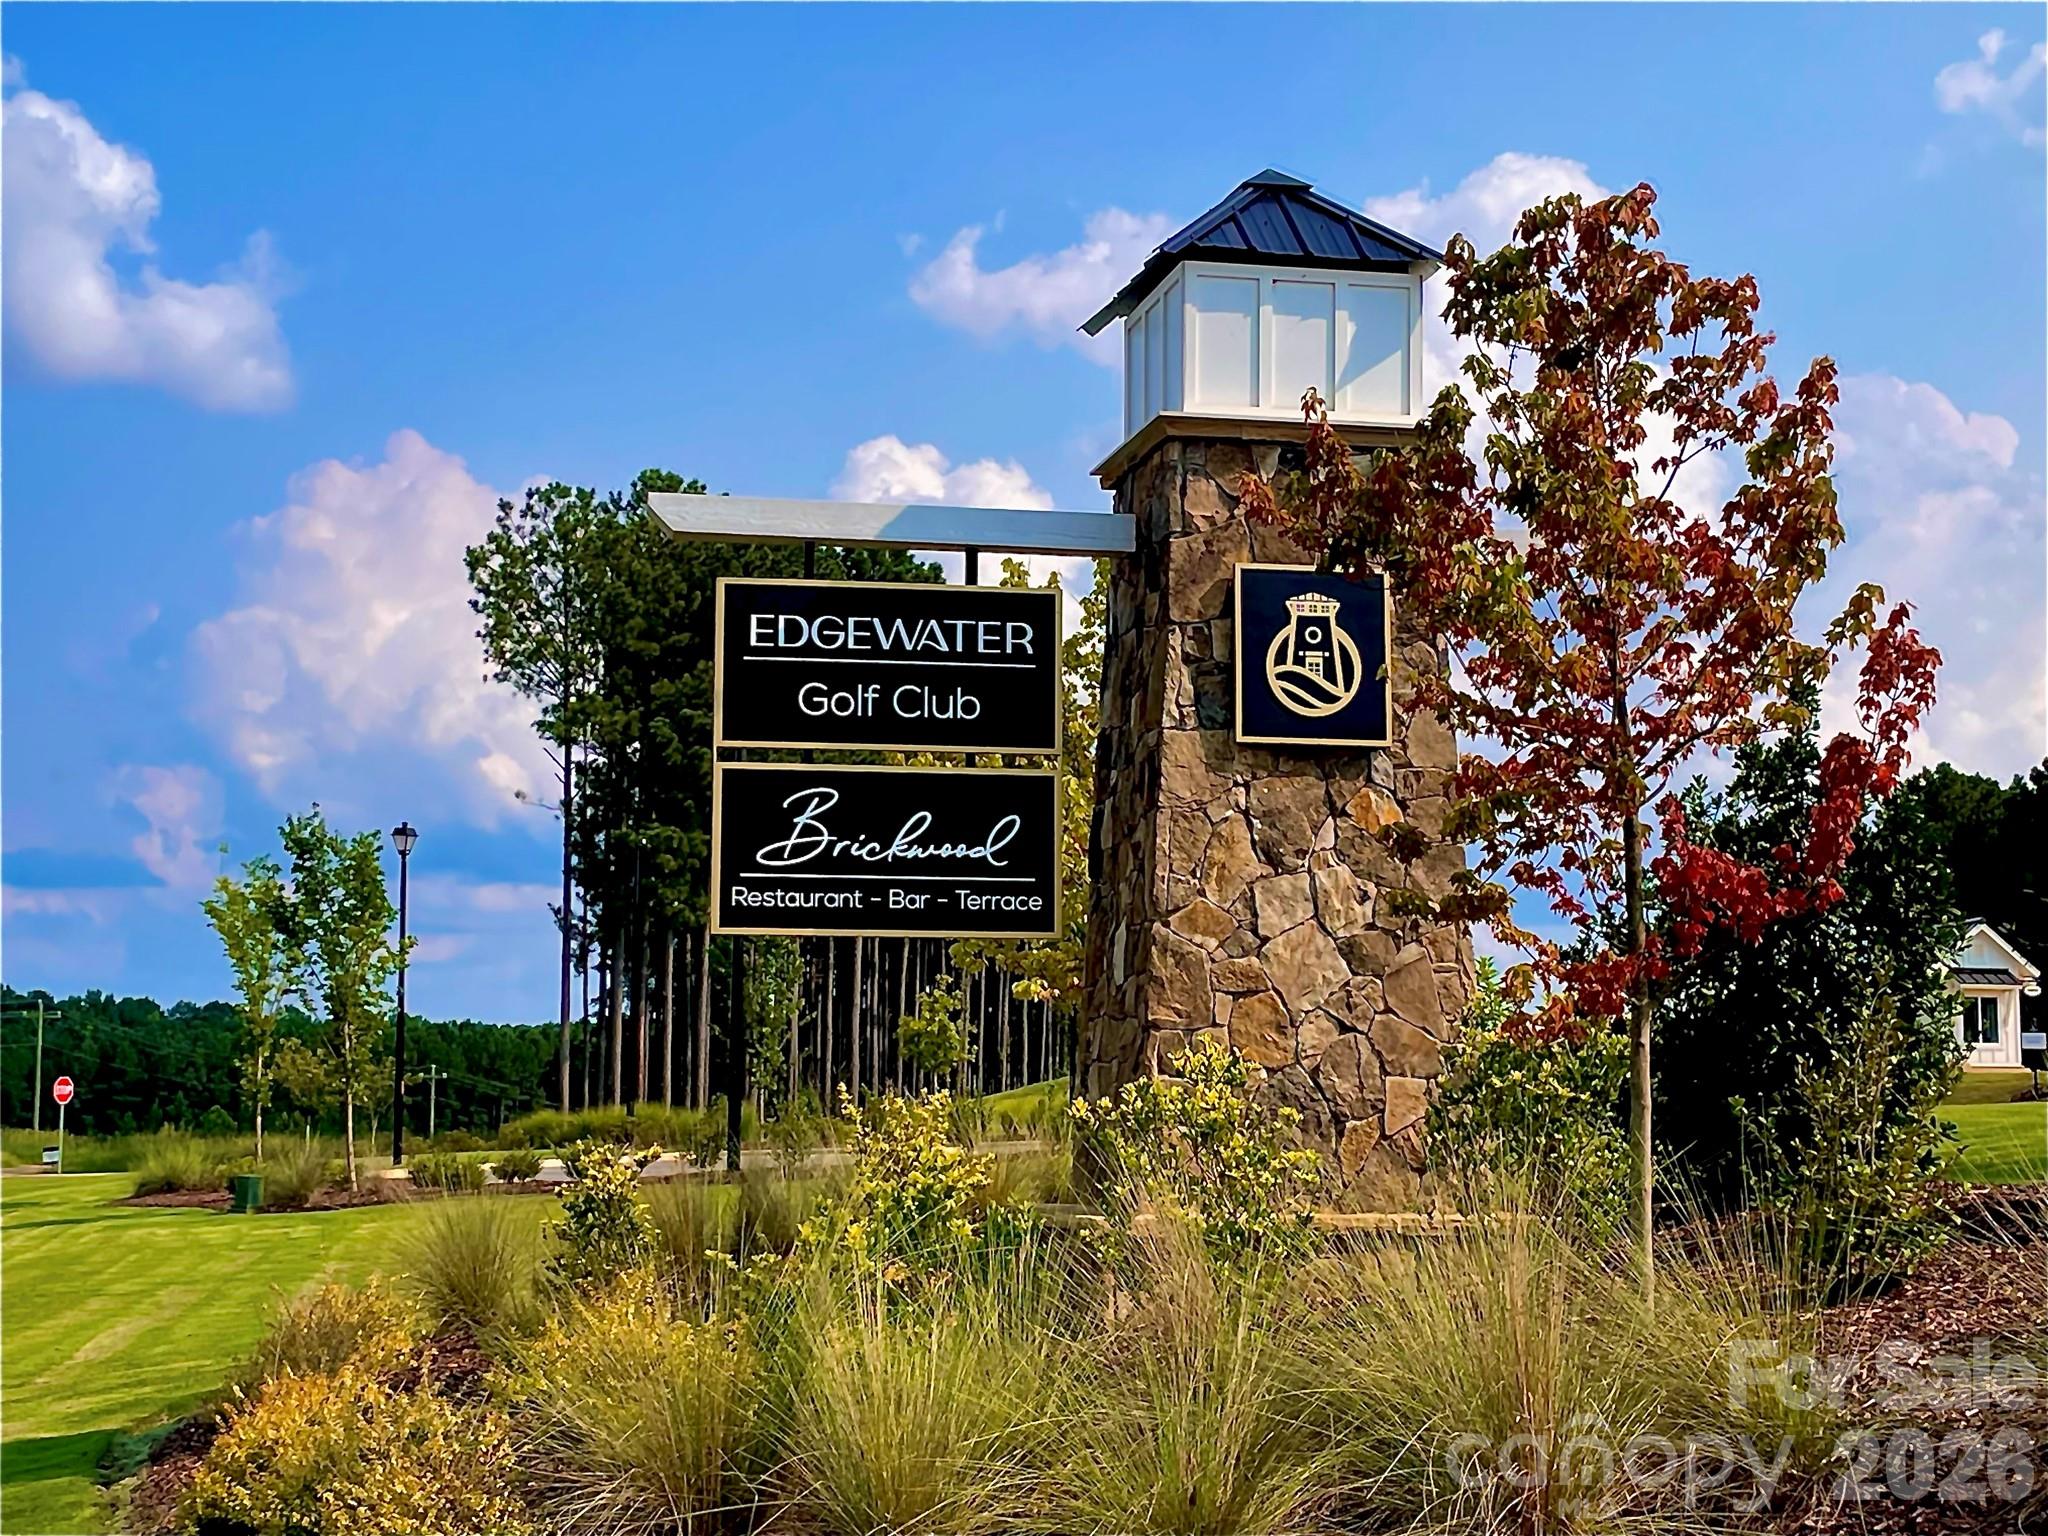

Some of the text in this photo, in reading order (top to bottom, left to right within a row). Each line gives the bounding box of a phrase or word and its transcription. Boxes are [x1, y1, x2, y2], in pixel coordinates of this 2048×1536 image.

[750, 614, 1034, 655] EDGEWATER
[798, 682, 981, 720] Golf Club
[756, 787, 1021, 867] Brickwood
[731, 886, 864, 909] Restaurant
[889, 889, 931, 910] Bar
[955, 889, 1043, 911] Terrace
